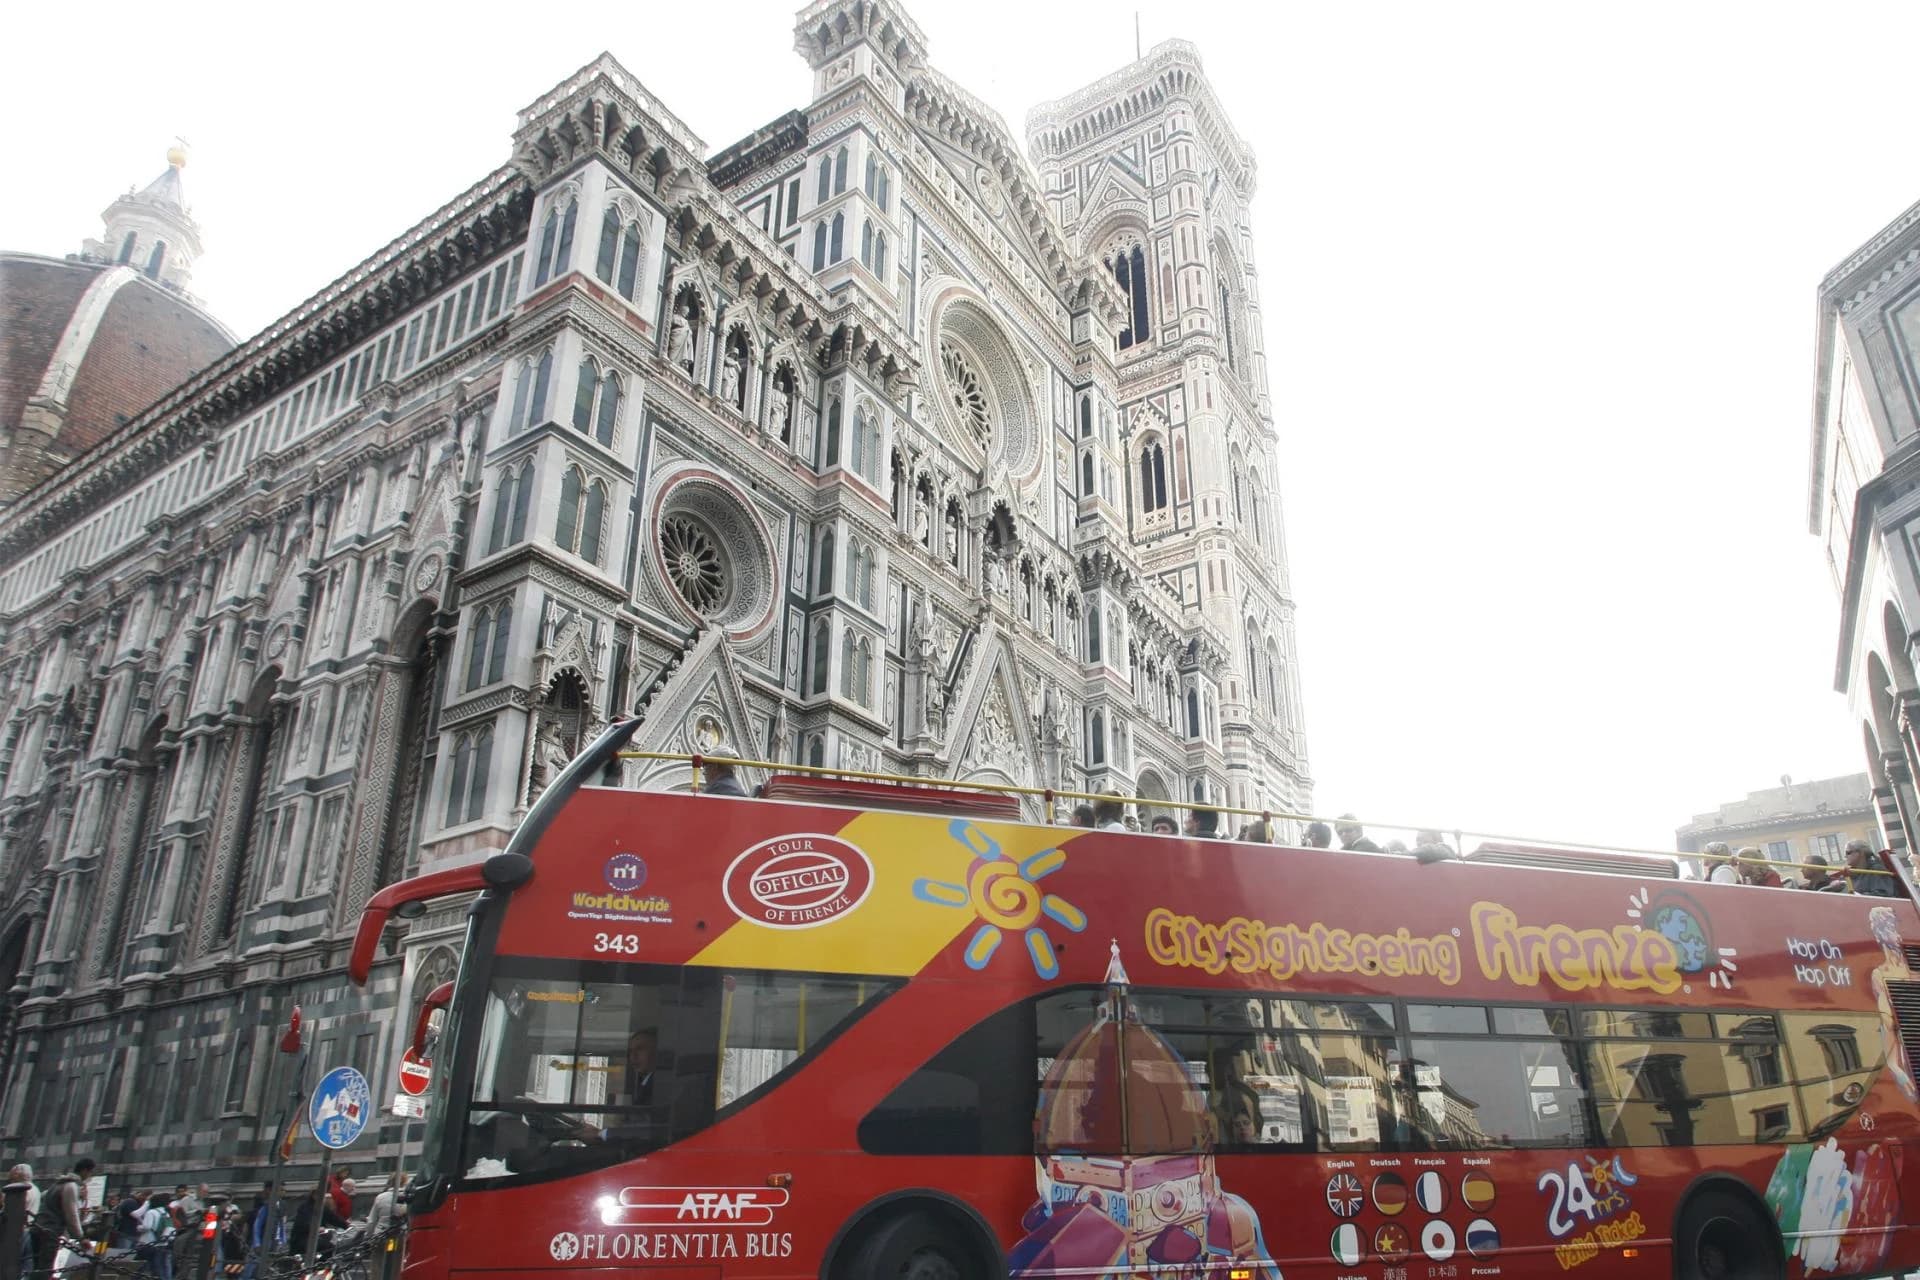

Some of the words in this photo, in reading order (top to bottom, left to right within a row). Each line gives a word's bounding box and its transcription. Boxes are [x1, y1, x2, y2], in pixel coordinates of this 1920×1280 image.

[767, 840, 814, 856] TOUR
[756, 868, 844, 895] OFFICIAL
[573, 892, 671, 913] Worldwide
[765, 909, 785, 921] OF
[791, 894, 852, 922] FIRENZE
[593, 932, 640, 955] 343
[1145, 907, 1462, 986] CitySightseeing
[1470, 901, 1682, 994] Firenze
[1786, 937, 1818, 961] Hop
[1820, 939, 1842, 960] On
[1794, 964, 1825, 988] Hop
[1828, 964, 1850, 986] Off
[1326, 1160, 1355, 1169] English
[1370, 1159, 1401, 1167] Deutsch
[1414, 1158, 1446, 1167] Français
[1462, 1157, 1491, 1166] Español
[677, 1192, 757, 1220] ATAF
[1538, 1163, 1596, 1237] 24
[1594, 1211, 1646, 1248] Ticket
[580, 1232, 739, 1260] FLORENTIA
[745, 1231, 792, 1258] BUS
[1428, 1265, 1457, 1278] 日本語
